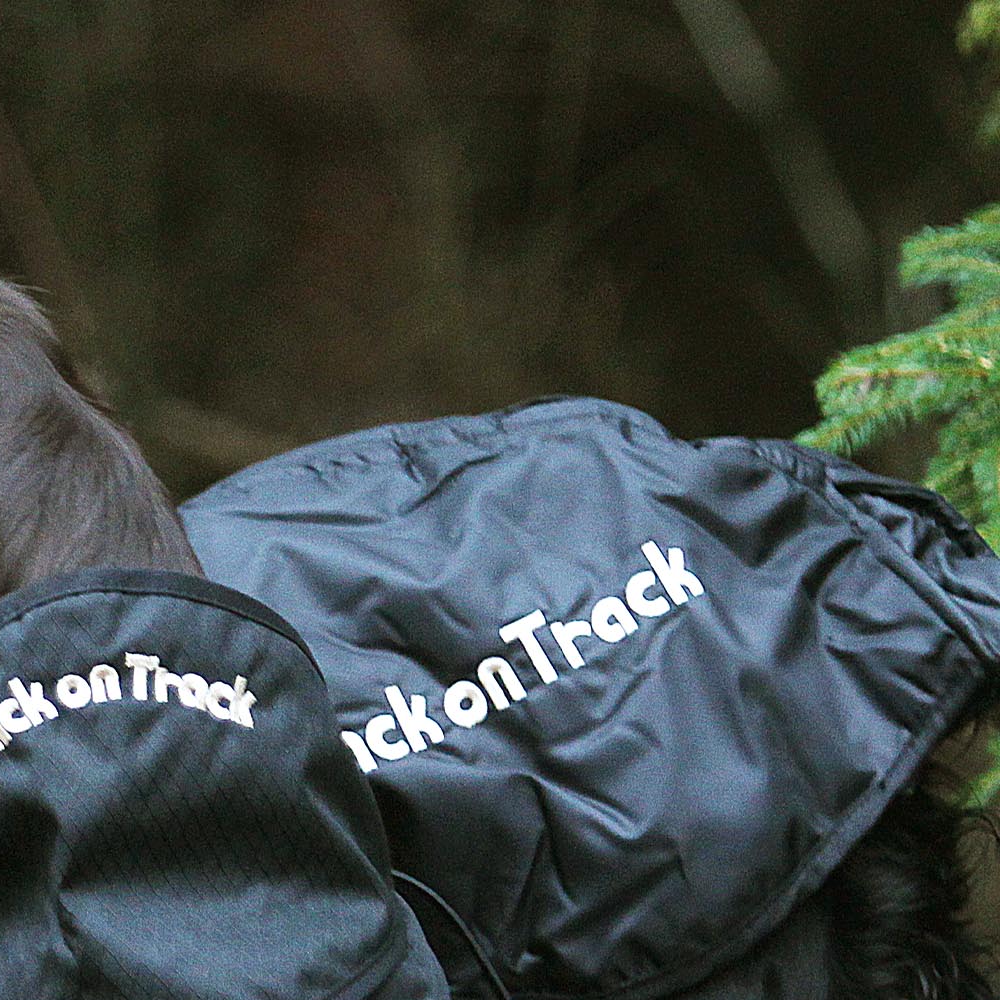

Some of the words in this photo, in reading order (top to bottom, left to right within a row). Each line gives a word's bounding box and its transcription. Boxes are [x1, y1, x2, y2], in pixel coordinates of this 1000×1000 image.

[56, 663, 123, 710] on
[124, 651, 257, 729] Track
[443, 656, 528, 729] on
[499, 540, 705, 685] Track
